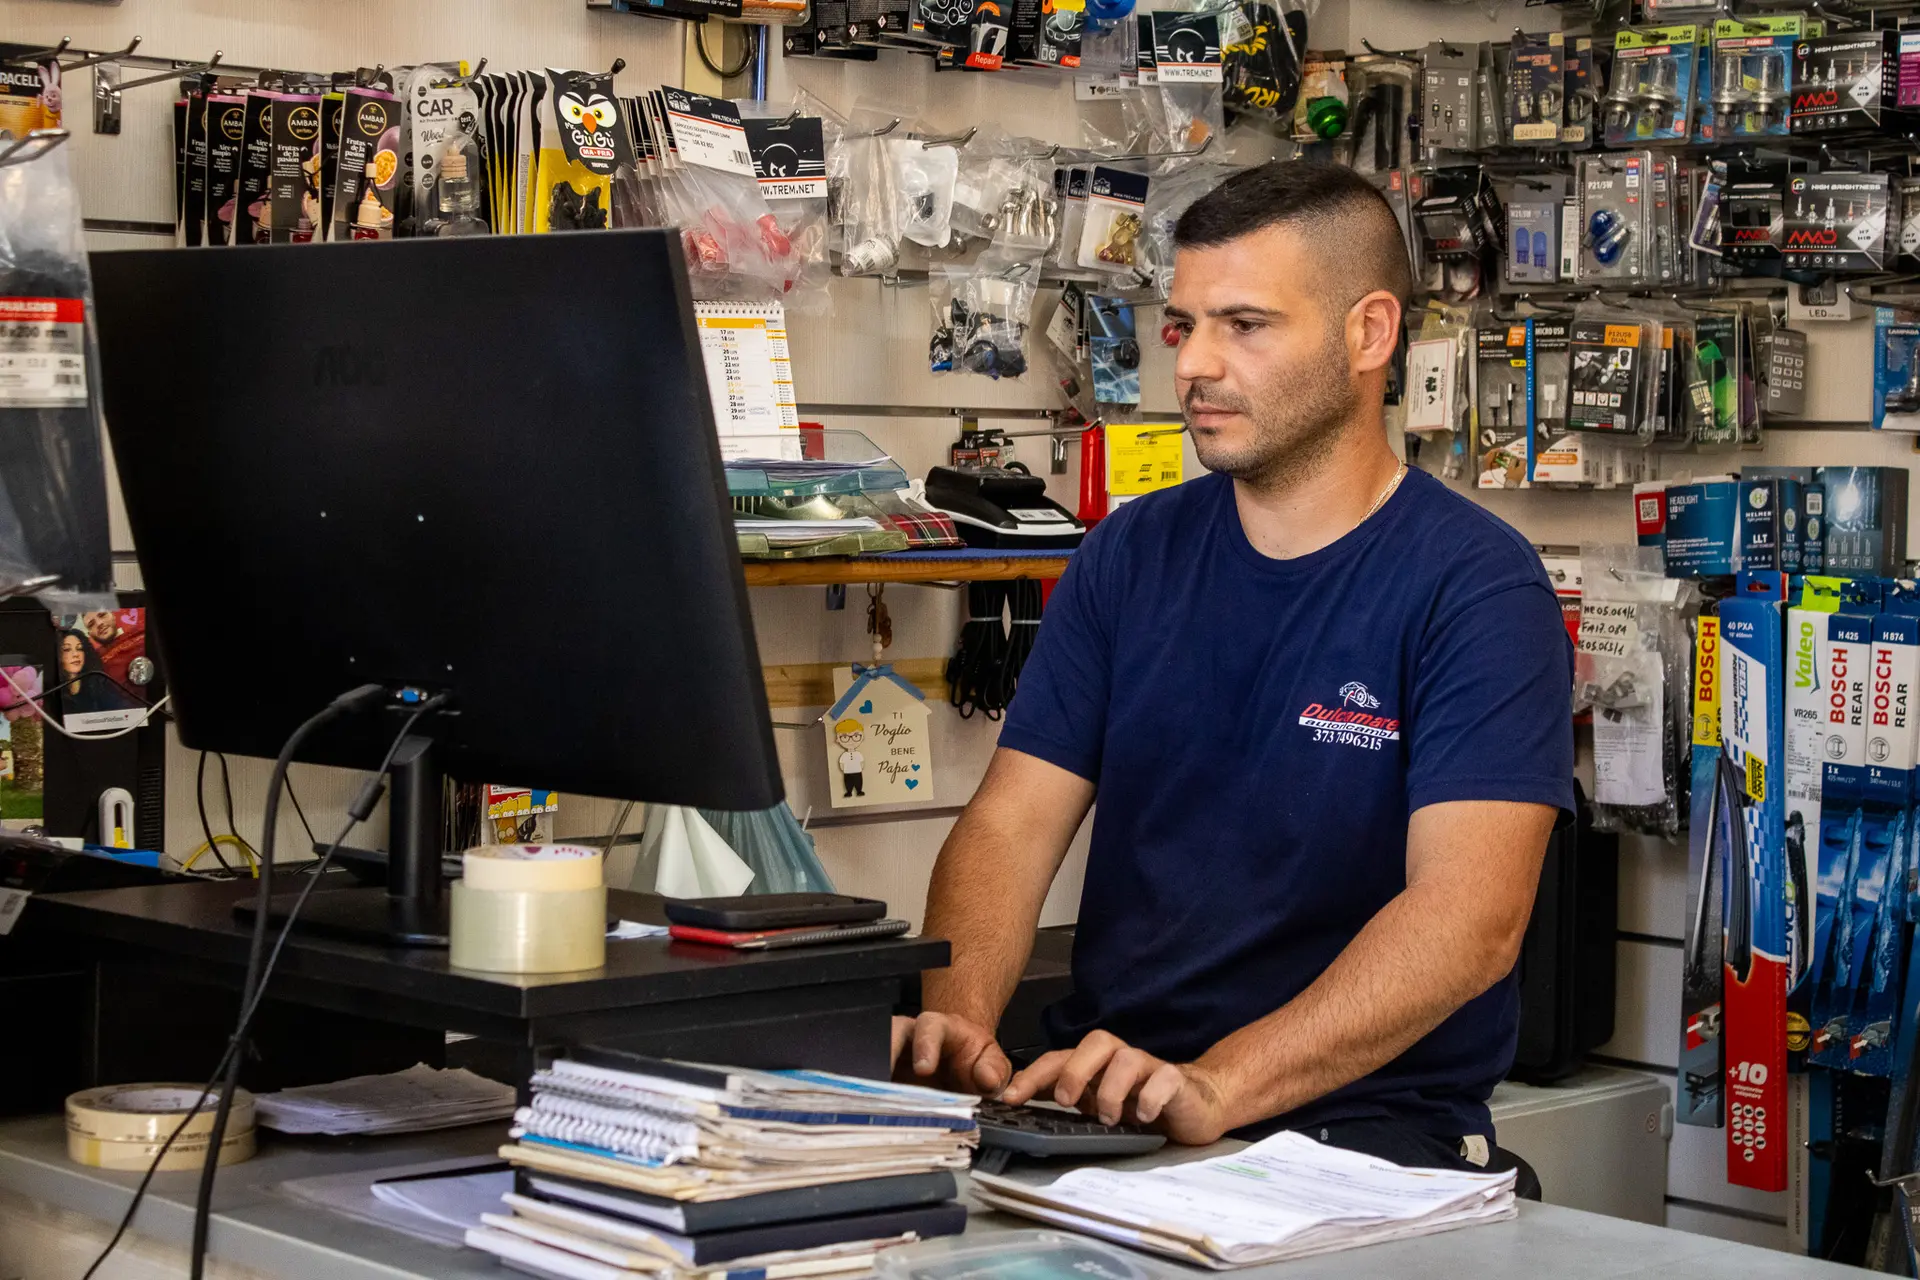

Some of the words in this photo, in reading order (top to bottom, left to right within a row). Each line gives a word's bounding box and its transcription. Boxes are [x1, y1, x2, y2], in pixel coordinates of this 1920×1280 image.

[1718, 25, 1731, 33] H4
[1619, 36, 1631, 44] H4
[1833, 41, 1877, 51] BRIGHTNESS
[974, 54, 996, 65] Repair
[1164, 69, 1213, 77] WWW.TREM.NET
[0, 72, 41, 87] RACELL
[417, 98, 454, 117] CAR
[670, 101, 691, 112] TREM
[360, 114, 385, 124] AMBAR
[346, 138, 367, 147] Frutas
[760, 183, 815, 196] W.TREM.NET
[1788, 230, 1837, 244] MAD
[1809, 308, 1827, 318] LED
[1535, 327, 1552, 336] MICRO
[1553, 327, 1564, 335] USB
[1669, 494, 1698, 505] HEADLIGHT
[1752, 534, 1768, 544] LLT
[1727, 622, 1736, 631] 40
[1737, 623, 1754, 631] PXA
[1845, 632, 1859, 641] 425
[1890, 632, 1904, 641] 874
[1794, 621, 1814, 689] Valeo
[1699, 621, 1717, 702] BOSCH
[1829, 647, 1849, 724] BOSCH
[1873, 649, 1893, 726] BOSCH
[1851, 681, 1864, 726] REAR
[1894, 683, 1908, 728] REAR
[1793, 708, 1818, 720] VR265
[870, 723, 912, 745] Voglio
[890, 747, 916, 756] BENE
[1755, 761, 1763, 798] NANO
[1729, 1061, 1768, 1086] +10
